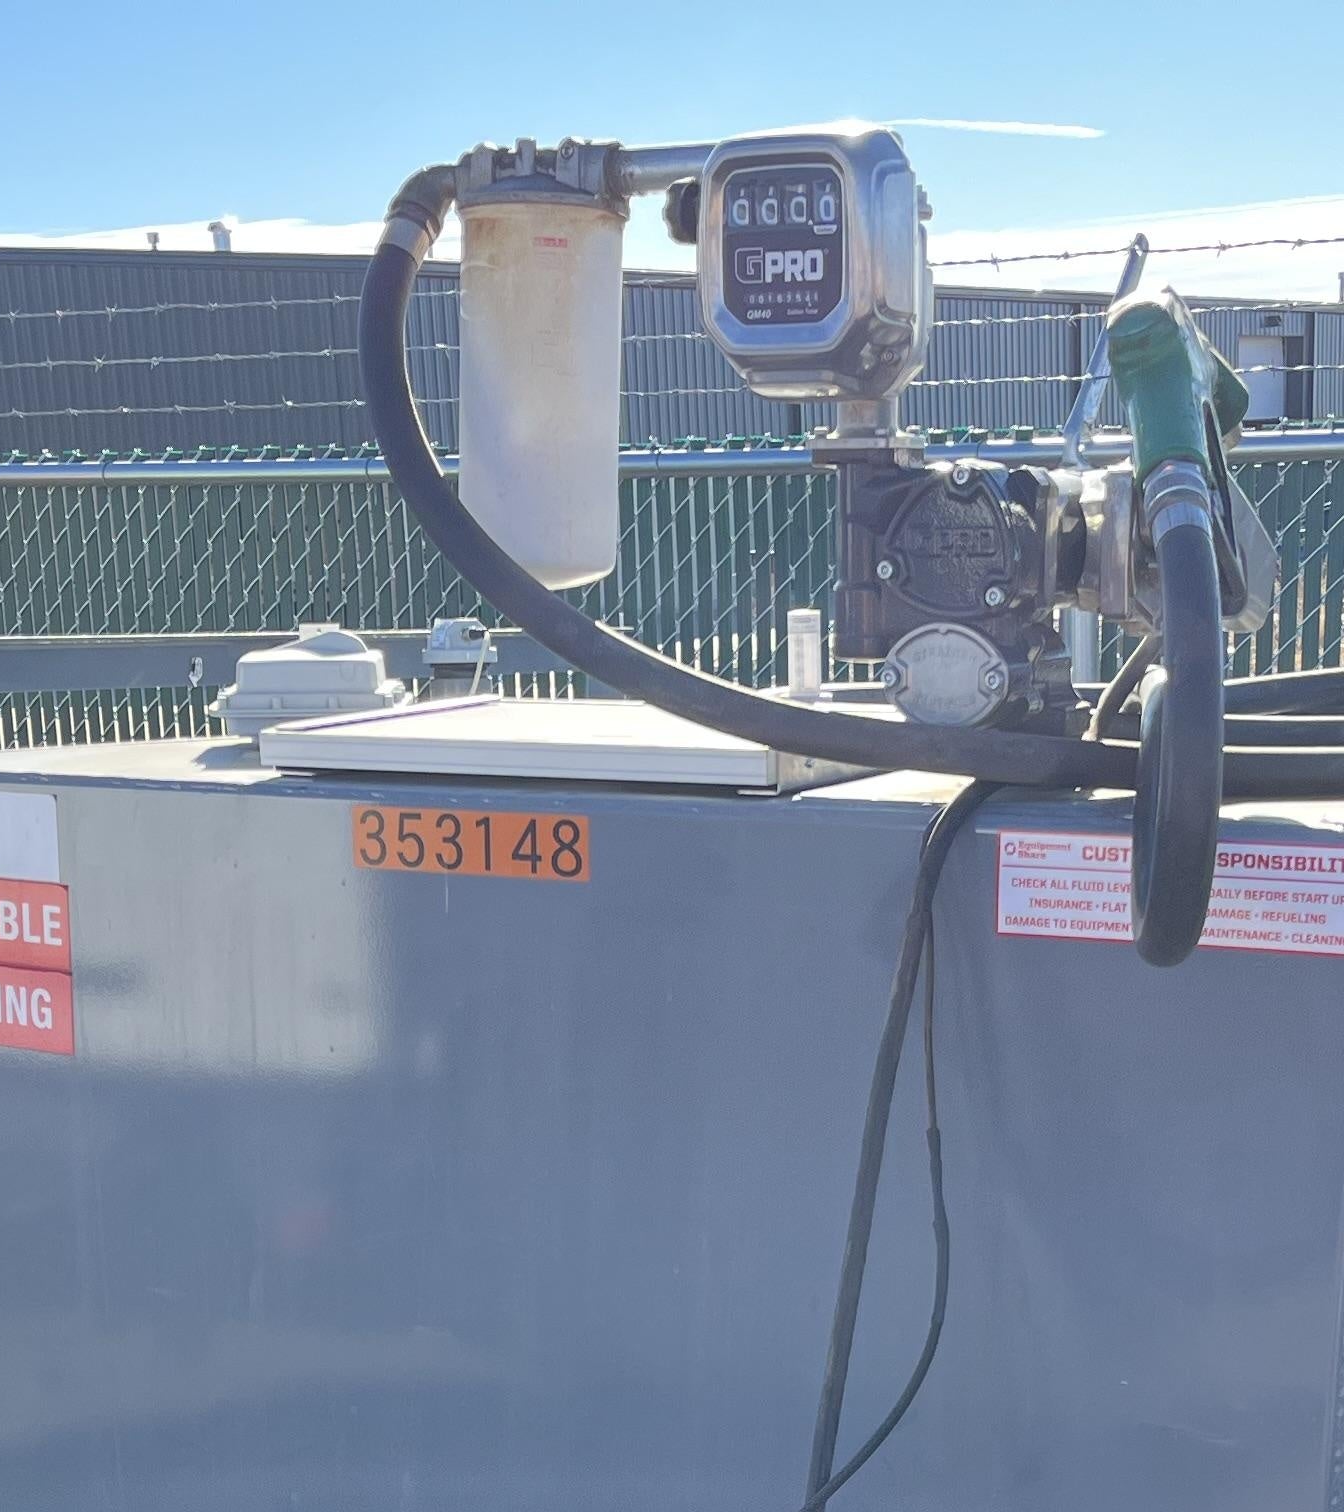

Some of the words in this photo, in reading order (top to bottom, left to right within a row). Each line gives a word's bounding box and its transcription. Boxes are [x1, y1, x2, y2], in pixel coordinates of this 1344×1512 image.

[735, 248, 824, 284] GPRO
[359, 809, 583, 878] 353148
[1082, 846, 1131, 863] CUST
[1011, 878, 1047, 889] CHECK
[1050, 880, 1069, 890] ALL
[1071, 880, 1103, 891] FLUID
[1244, 890, 1288, 902] BEFORE
[1292, 893, 1329, 905] START
[1005, 916, 1051, 928] DAMAGE
[1053, 919, 1067, 929] TO
[1070, 920, 1132, 932] EQUIPMEN
[1029, 898, 1092, 911] INSURANCE
[1102, 902, 1127, 913] FLAT
[1262, 911, 1326, 924] REFUELING
